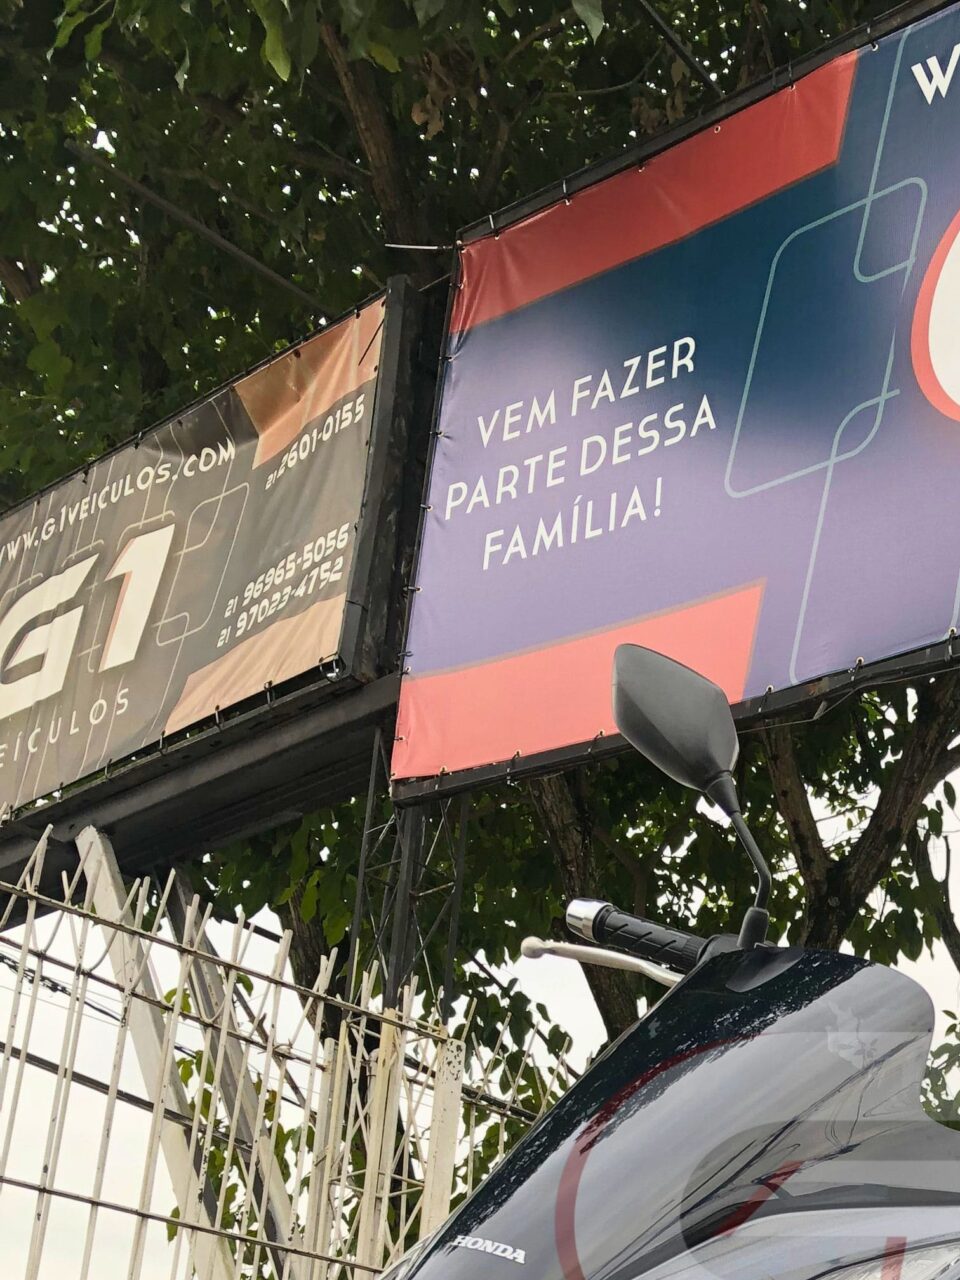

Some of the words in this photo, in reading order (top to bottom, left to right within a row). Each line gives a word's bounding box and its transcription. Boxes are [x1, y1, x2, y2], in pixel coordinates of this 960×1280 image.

[277, 393, 365, 479] 2601-0155
[477, 390, 556, 448] VEM
[571, 336, 696, 416] FAZER
[445, 446, 567, 520] PARTE
[580, 394, 717, 476] DESSA
[224, 598, 238, 618] 21
[243, 522, 349, 608] 96965-5056
[483, 477, 662, 570] FAMÍLIA!
[0, 523, 175, 720] G1
[217, 628, 231, 648] 21
[235, 555, 343, 638] 97023-4752
[451, 1235, 526, 1264] HONDA
